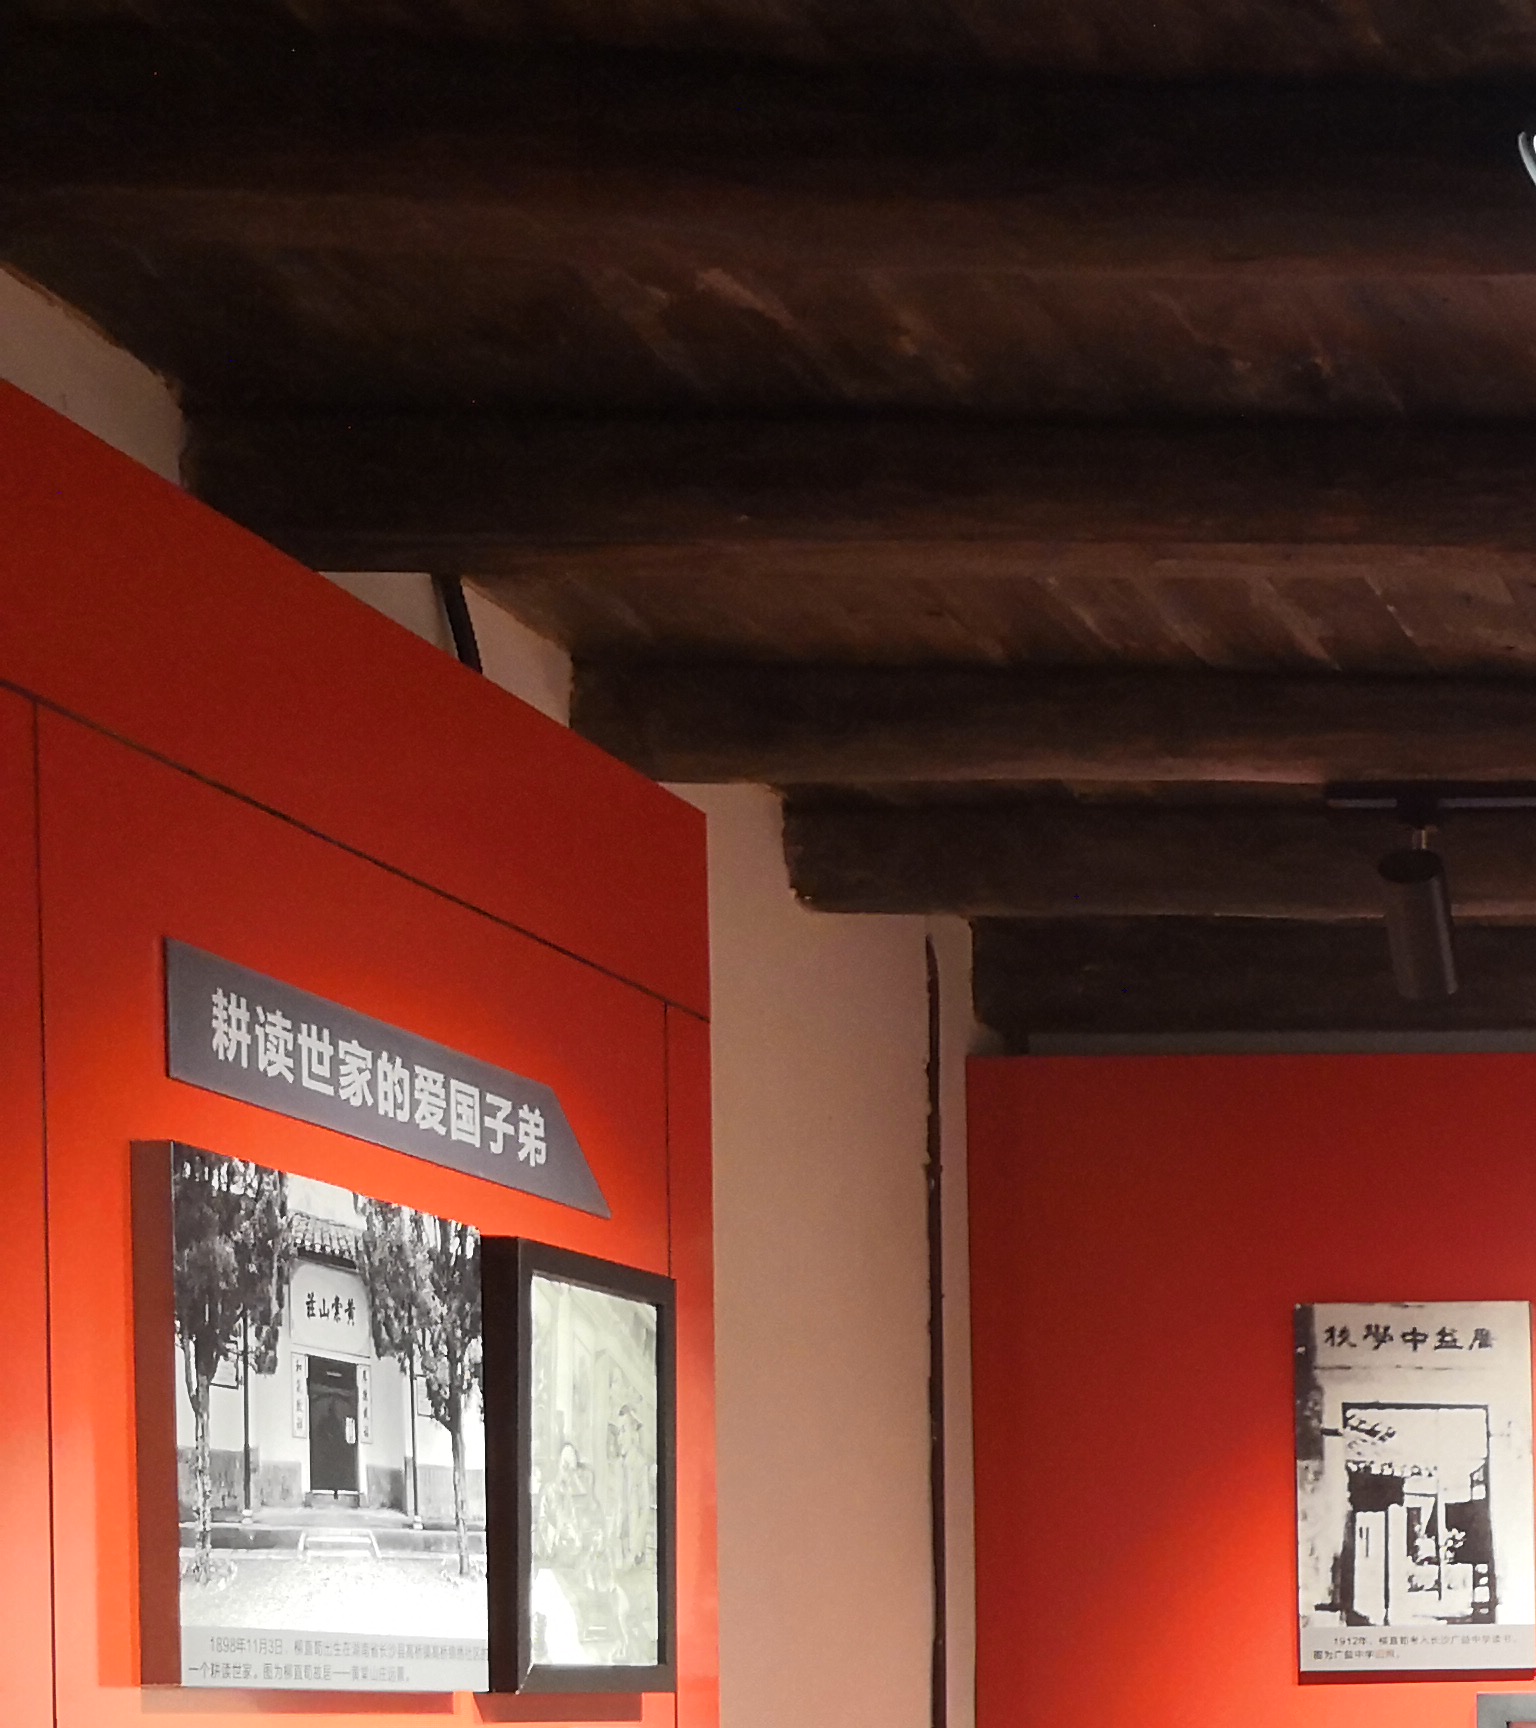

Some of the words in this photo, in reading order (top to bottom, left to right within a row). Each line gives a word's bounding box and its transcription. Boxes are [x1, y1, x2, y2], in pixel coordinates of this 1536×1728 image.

[211, 987, 548, 1167] 耕读世家的爱国子弟
